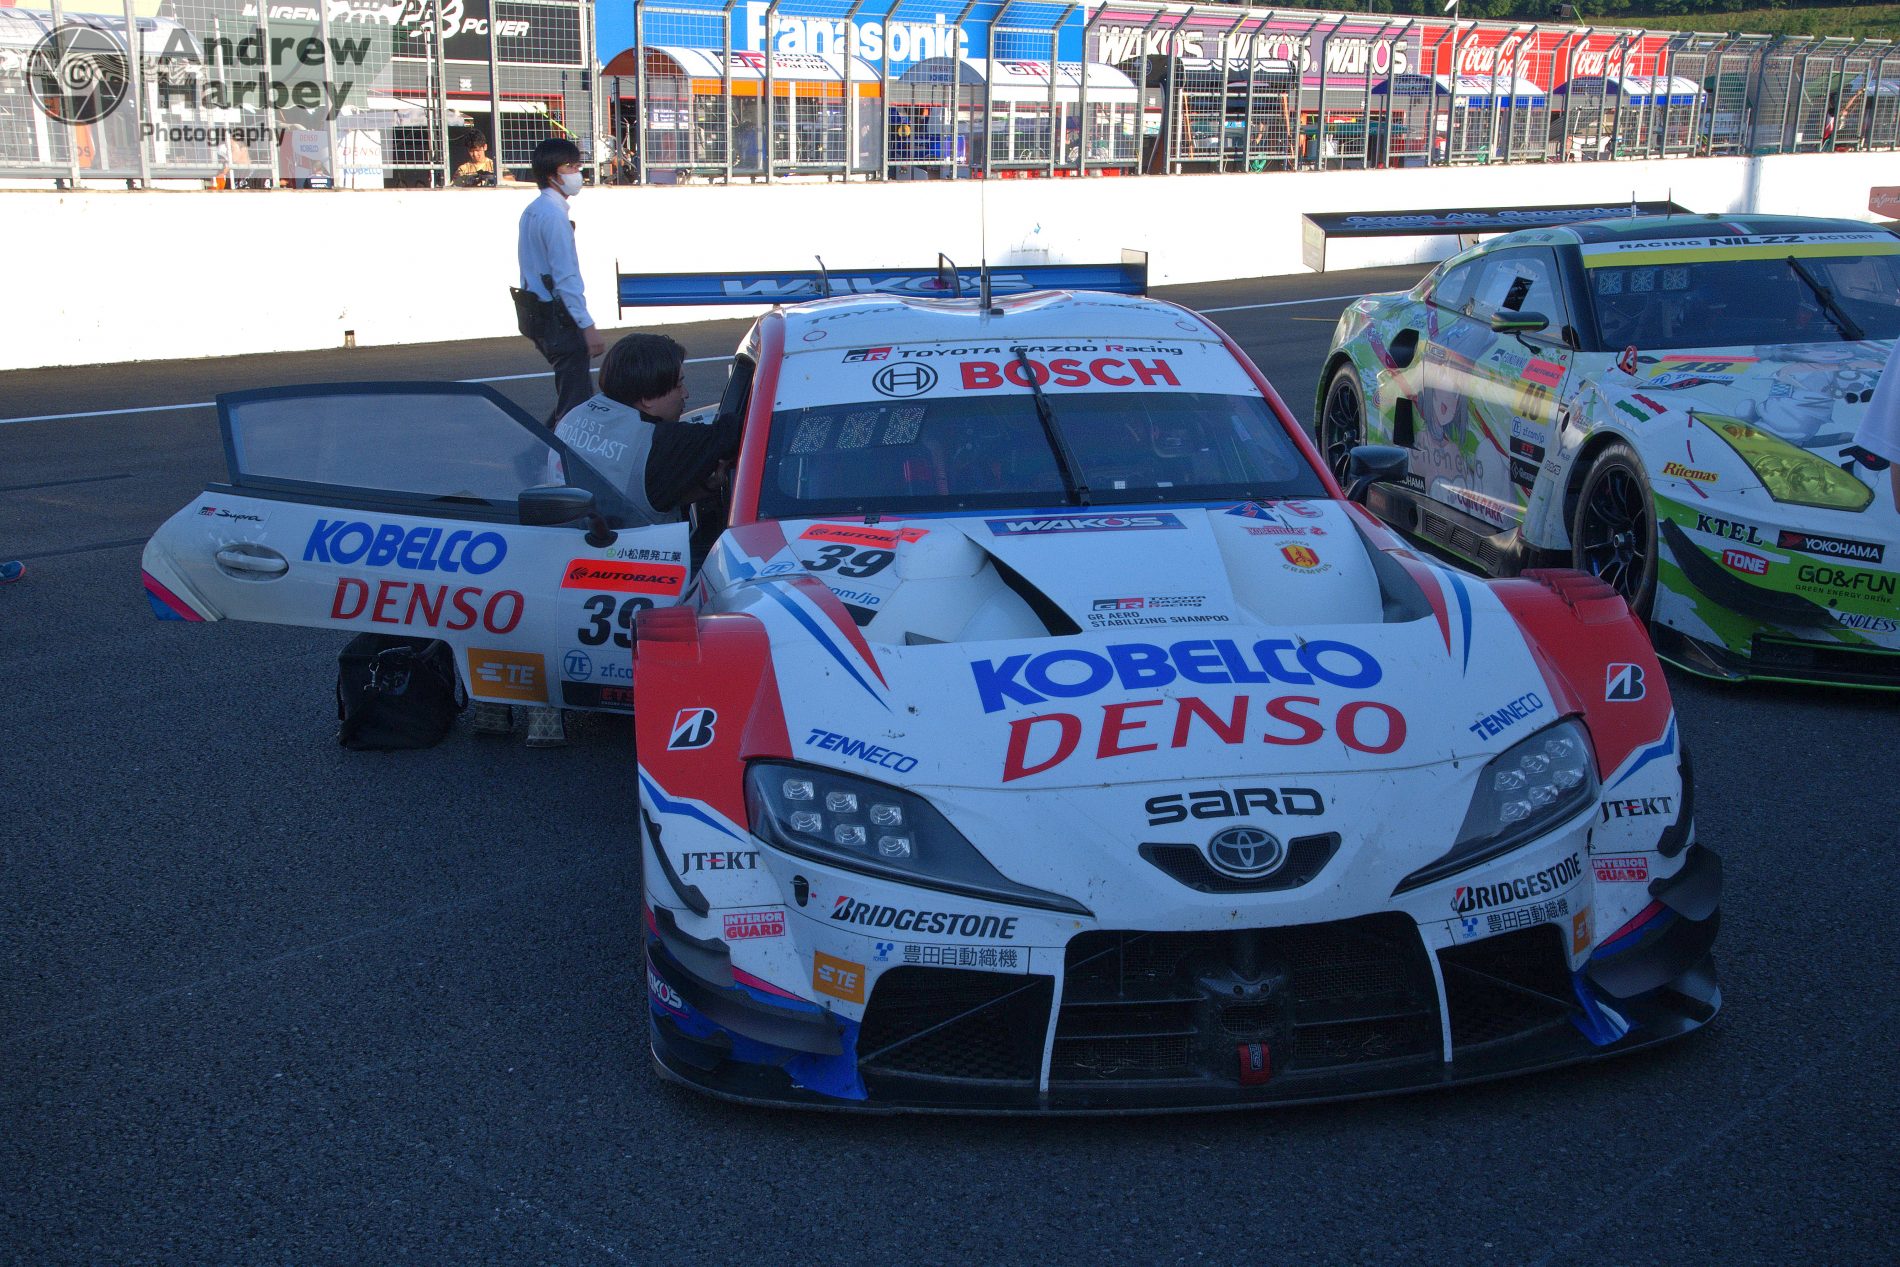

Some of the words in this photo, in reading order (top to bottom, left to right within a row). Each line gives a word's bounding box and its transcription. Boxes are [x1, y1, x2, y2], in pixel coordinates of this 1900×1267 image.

[747, 2, 969, 62] Panasonic
[1618, 240, 1702, 250] RACING
[1709, 235, 1805, 247] NILZZ
[1808, 233, 1874, 242] FACTORY
[897, 347, 1001, 358] TOYOTA
[1008, 345, 1098, 354] GAZOO
[1105, 345, 1183, 355] Racing
[960, 358, 1182, 390] BOSCH
[1663, 462, 1719, 482] Ritemas
[215, 509, 265, 523] Supra
[1696, 514, 1763, 546] KTEL
[303, 519, 508, 575] KOBELCO
[617, 548, 682, 562] 小松開発工業
[1805, 538, 1880, 560] YOKOHAMA
[801, 544, 896, 578] 39
[1726, 551, 1766, 574] TONE
[588, 571, 680, 585] AUTOBACS
[1797, 564, 1896, 595] GO&FUN
[331, 577, 525, 634] DENSO
[1795, 584, 1824, 594] GREEN
[1826, 588, 1861, 599] ENERGY
[1864, 593, 1893, 604] DRINK
[1088, 613, 1105, 621] GR
[1108, 611, 1140, 619] AERO
[1091, 617, 1168, 628] STABILIZING
[1171, 614, 1229, 624] SHAMPOO
[1838, 613, 1897, 633] ENDLESS
[601, 663, 633, 679] zf.co
[970, 639, 1383, 714] KOBELCO
[1469, 692, 1544, 741] TENNECO
[1002, 695, 1408, 783] DENSO
[806, 728, 919, 774] TENNECO
[1601, 796, 1673, 823] JTEKT
[680, 851, 760, 875] JTEKT
[1593, 857, 1647, 869] INTERIOR
[1453, 852, 1583, 913] BRIDGESTONE
[1597, 869, 1647, 881] GUARD
[724, 911, 784, 925] INTERIOR
[830, 895, 1019, 940] BRIDGESTONE
[1486, 899, 1570, 934] 豊田自動織機
[726, 923, 784, 940] GUARD
[902, 945, 1019, 969] 豊田自動織機
